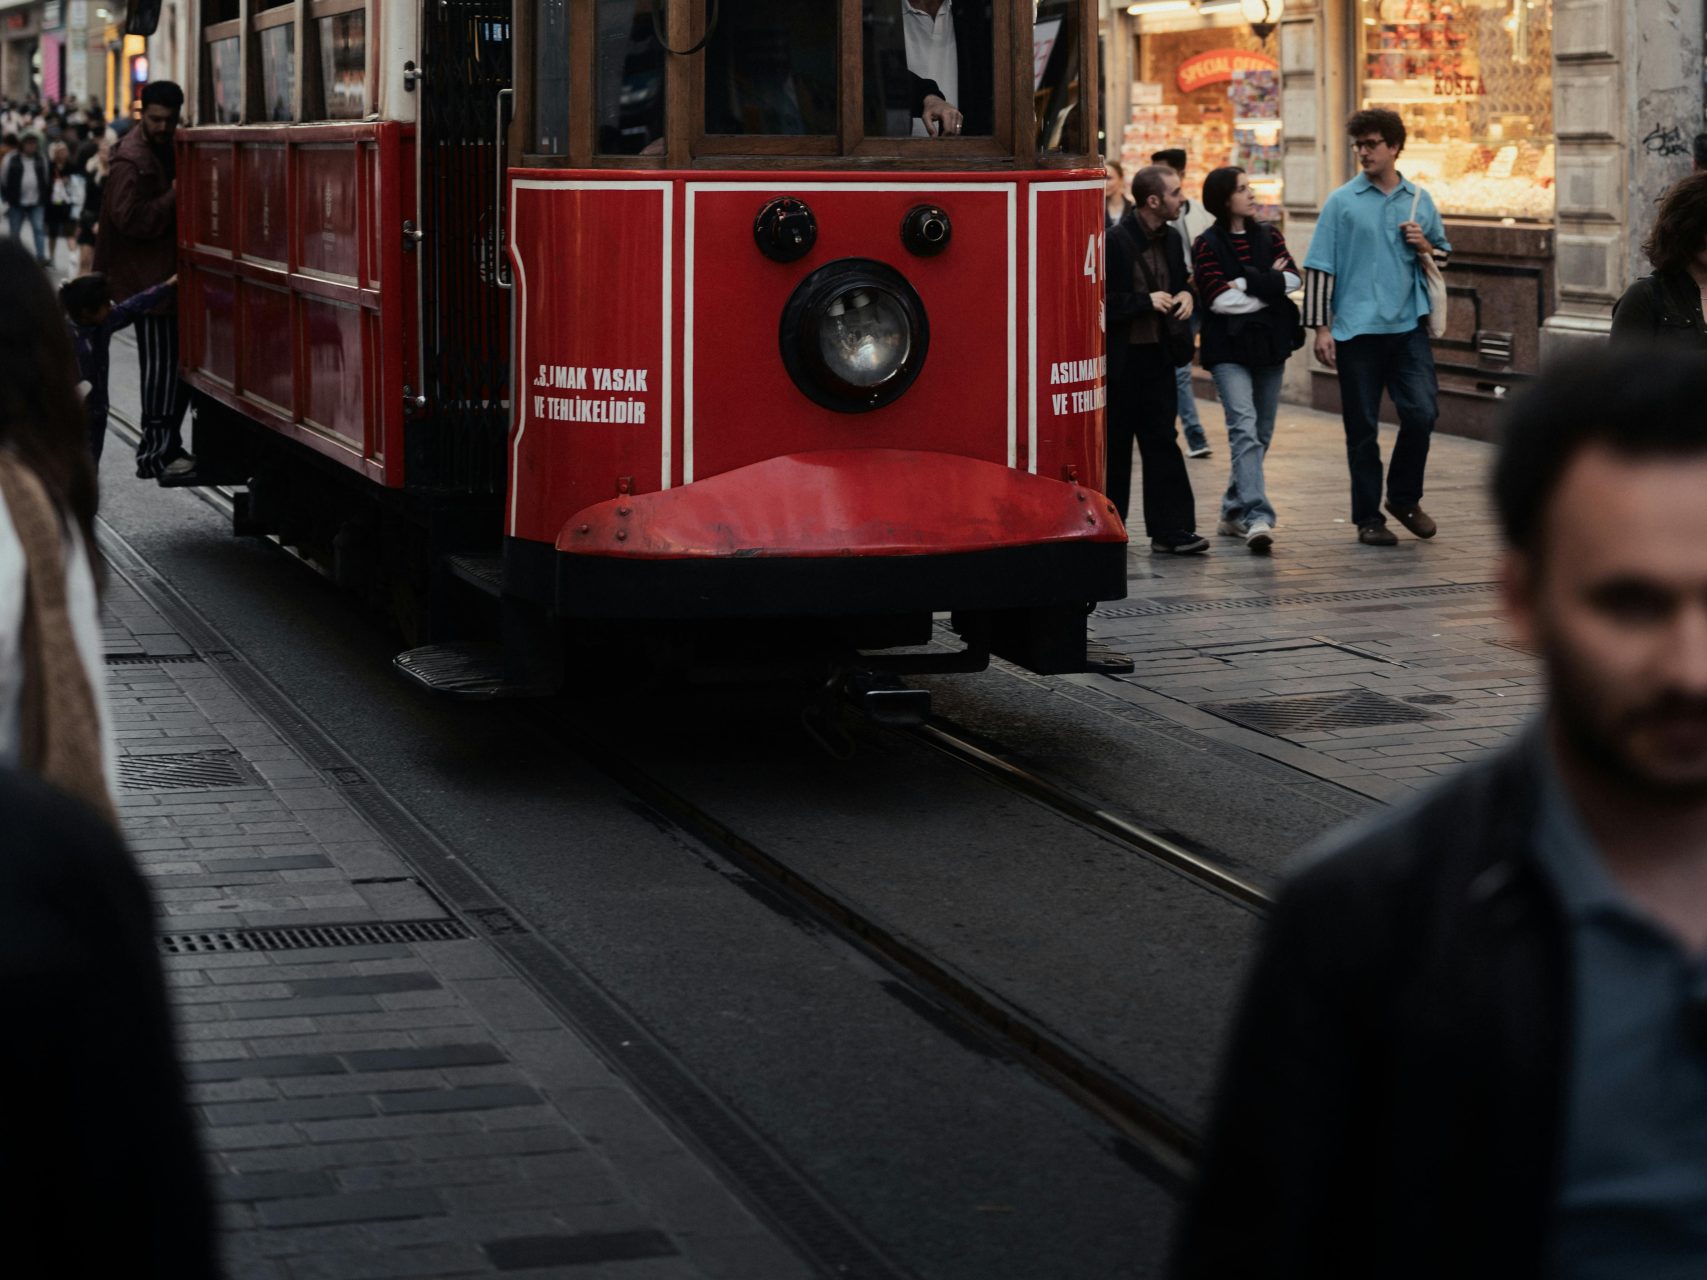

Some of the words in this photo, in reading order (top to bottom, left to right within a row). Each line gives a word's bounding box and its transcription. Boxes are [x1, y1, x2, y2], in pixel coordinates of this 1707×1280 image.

[1180, 56, 1229, 85] SPECIAL
[1434, 73, 1487, 96] KOSKA
[1083, 231, 1107, 285] 41
[533, 364, 588, 391] SMAK
[592, 367, 648, 392] YASAK
[1050, 357, 1098, 385] ASILMAK
[533, 395, 545, 419] VE
[547, 395, 646, 424] TEHLİKELİDİR
[1051, 393, 1068, 416] VE
